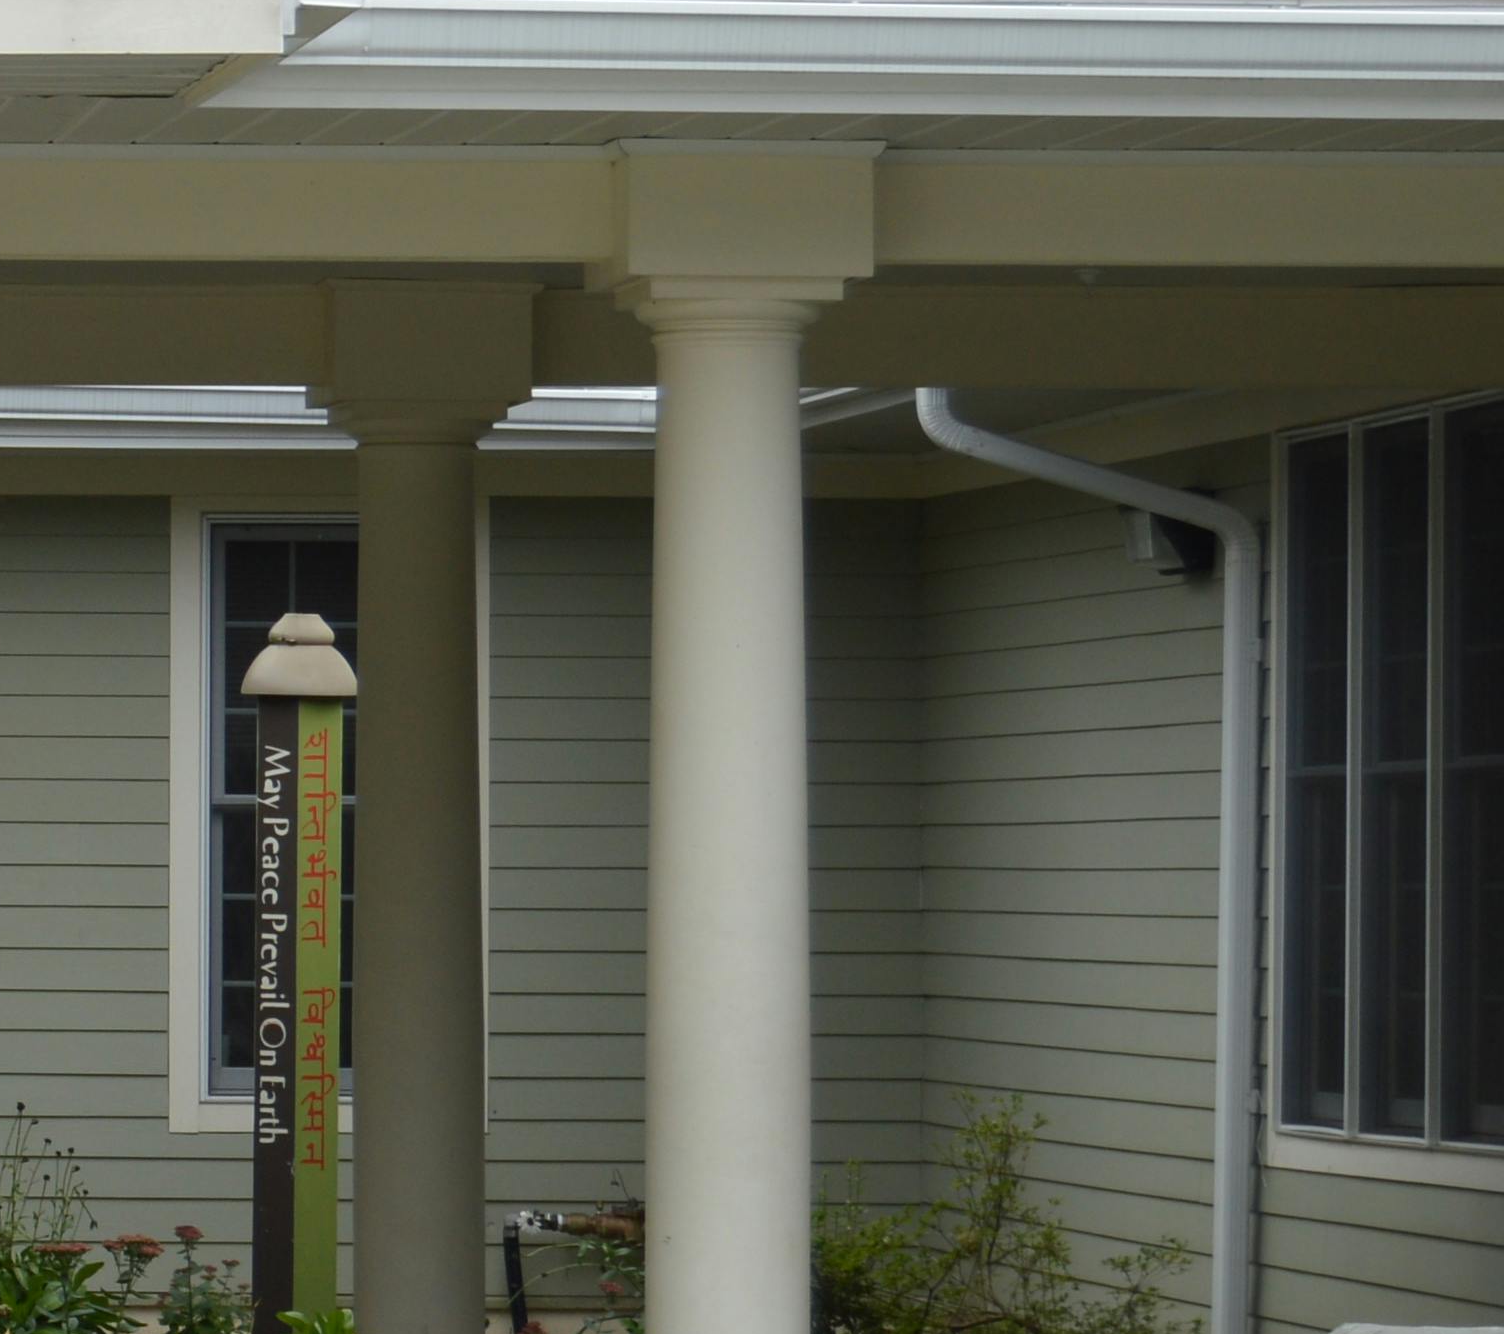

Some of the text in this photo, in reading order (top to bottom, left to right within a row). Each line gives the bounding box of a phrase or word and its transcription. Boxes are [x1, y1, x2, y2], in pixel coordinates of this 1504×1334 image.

[256, 744, 291, 1145] May Peace Prevail On Earth
